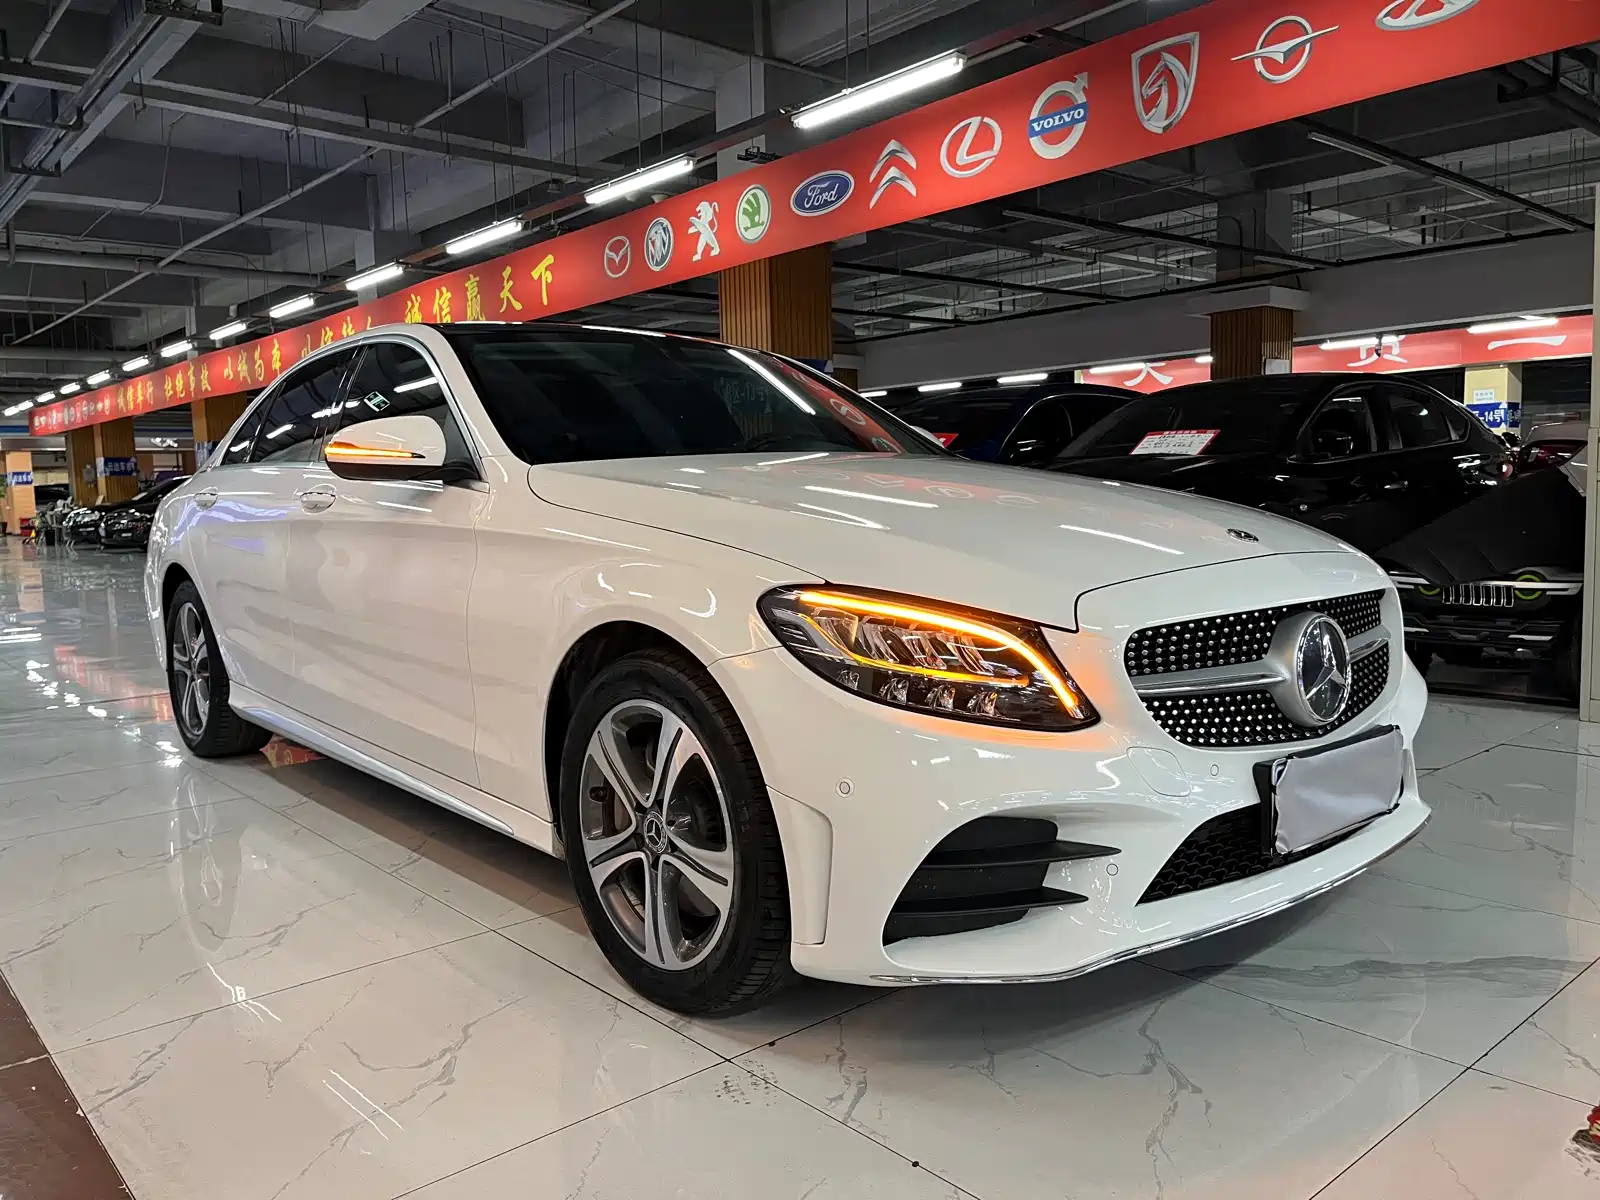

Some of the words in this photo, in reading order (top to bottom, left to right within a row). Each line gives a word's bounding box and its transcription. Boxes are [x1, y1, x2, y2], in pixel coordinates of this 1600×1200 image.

[1031, 108, 1085, 132] VOLVO
[804, 181, 839, 208] Ford
[404, 254, 555, 323] 诚信赢天下
